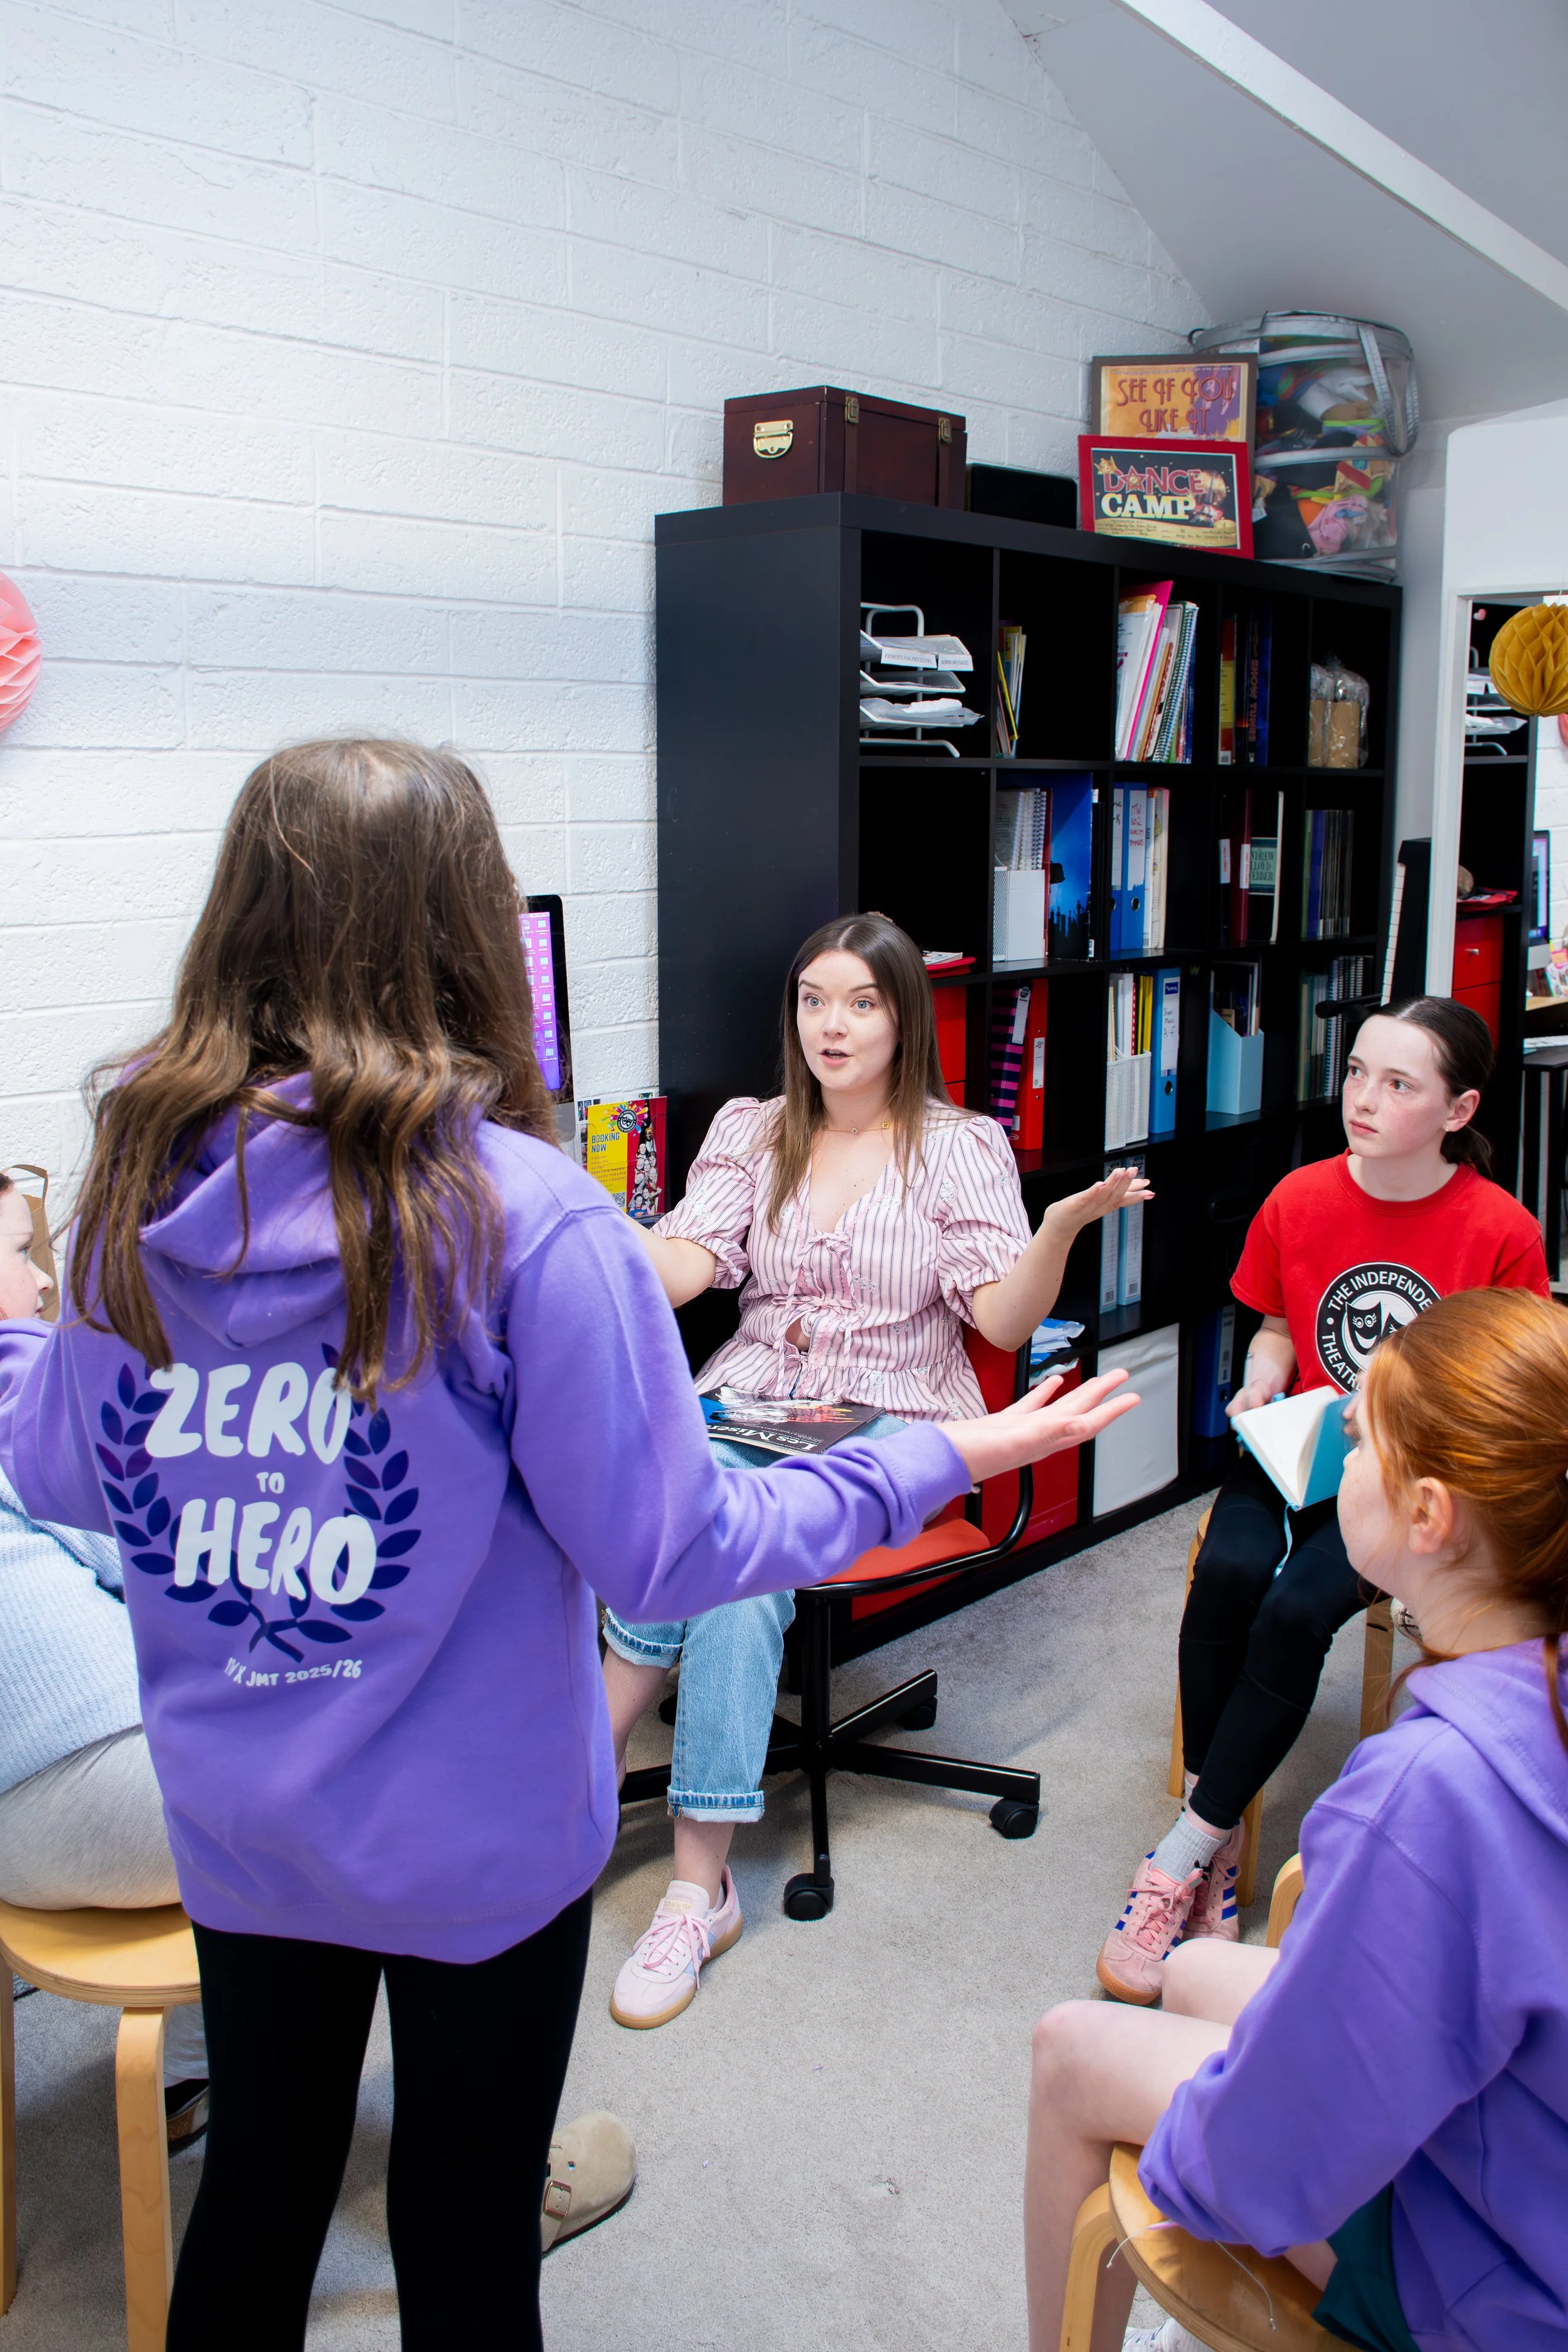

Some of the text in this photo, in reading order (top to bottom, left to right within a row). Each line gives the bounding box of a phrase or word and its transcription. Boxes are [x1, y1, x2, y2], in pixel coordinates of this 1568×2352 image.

[1117, 375, 1234, 406] SEE IF YOU
[1138, 407, 1209, 434] LIKE IT
[1103, 465, 1204, 495] DANCE
[1101, 493, 1196, 520] CAMP
[1251, 851, 1274, 861] NDREW
[1251, 871, 1273, 881] EBBER
[592, 1133, 620, 1143] BOOKING
[592, 1144, 606, 1153] NOW
[1327, 1271, 1433, 1312] THE INDEPENDE
[144, 1361, 352, 1465] ZERO
[776, 1436, 818, 1450] Les
[256, 1471, 286, 1495] TO
[174, 1496, 378, 1605] HERO
[245, 1670, 280, 1687] JMT
[284, 1659, 363, 1684] 2025/26
